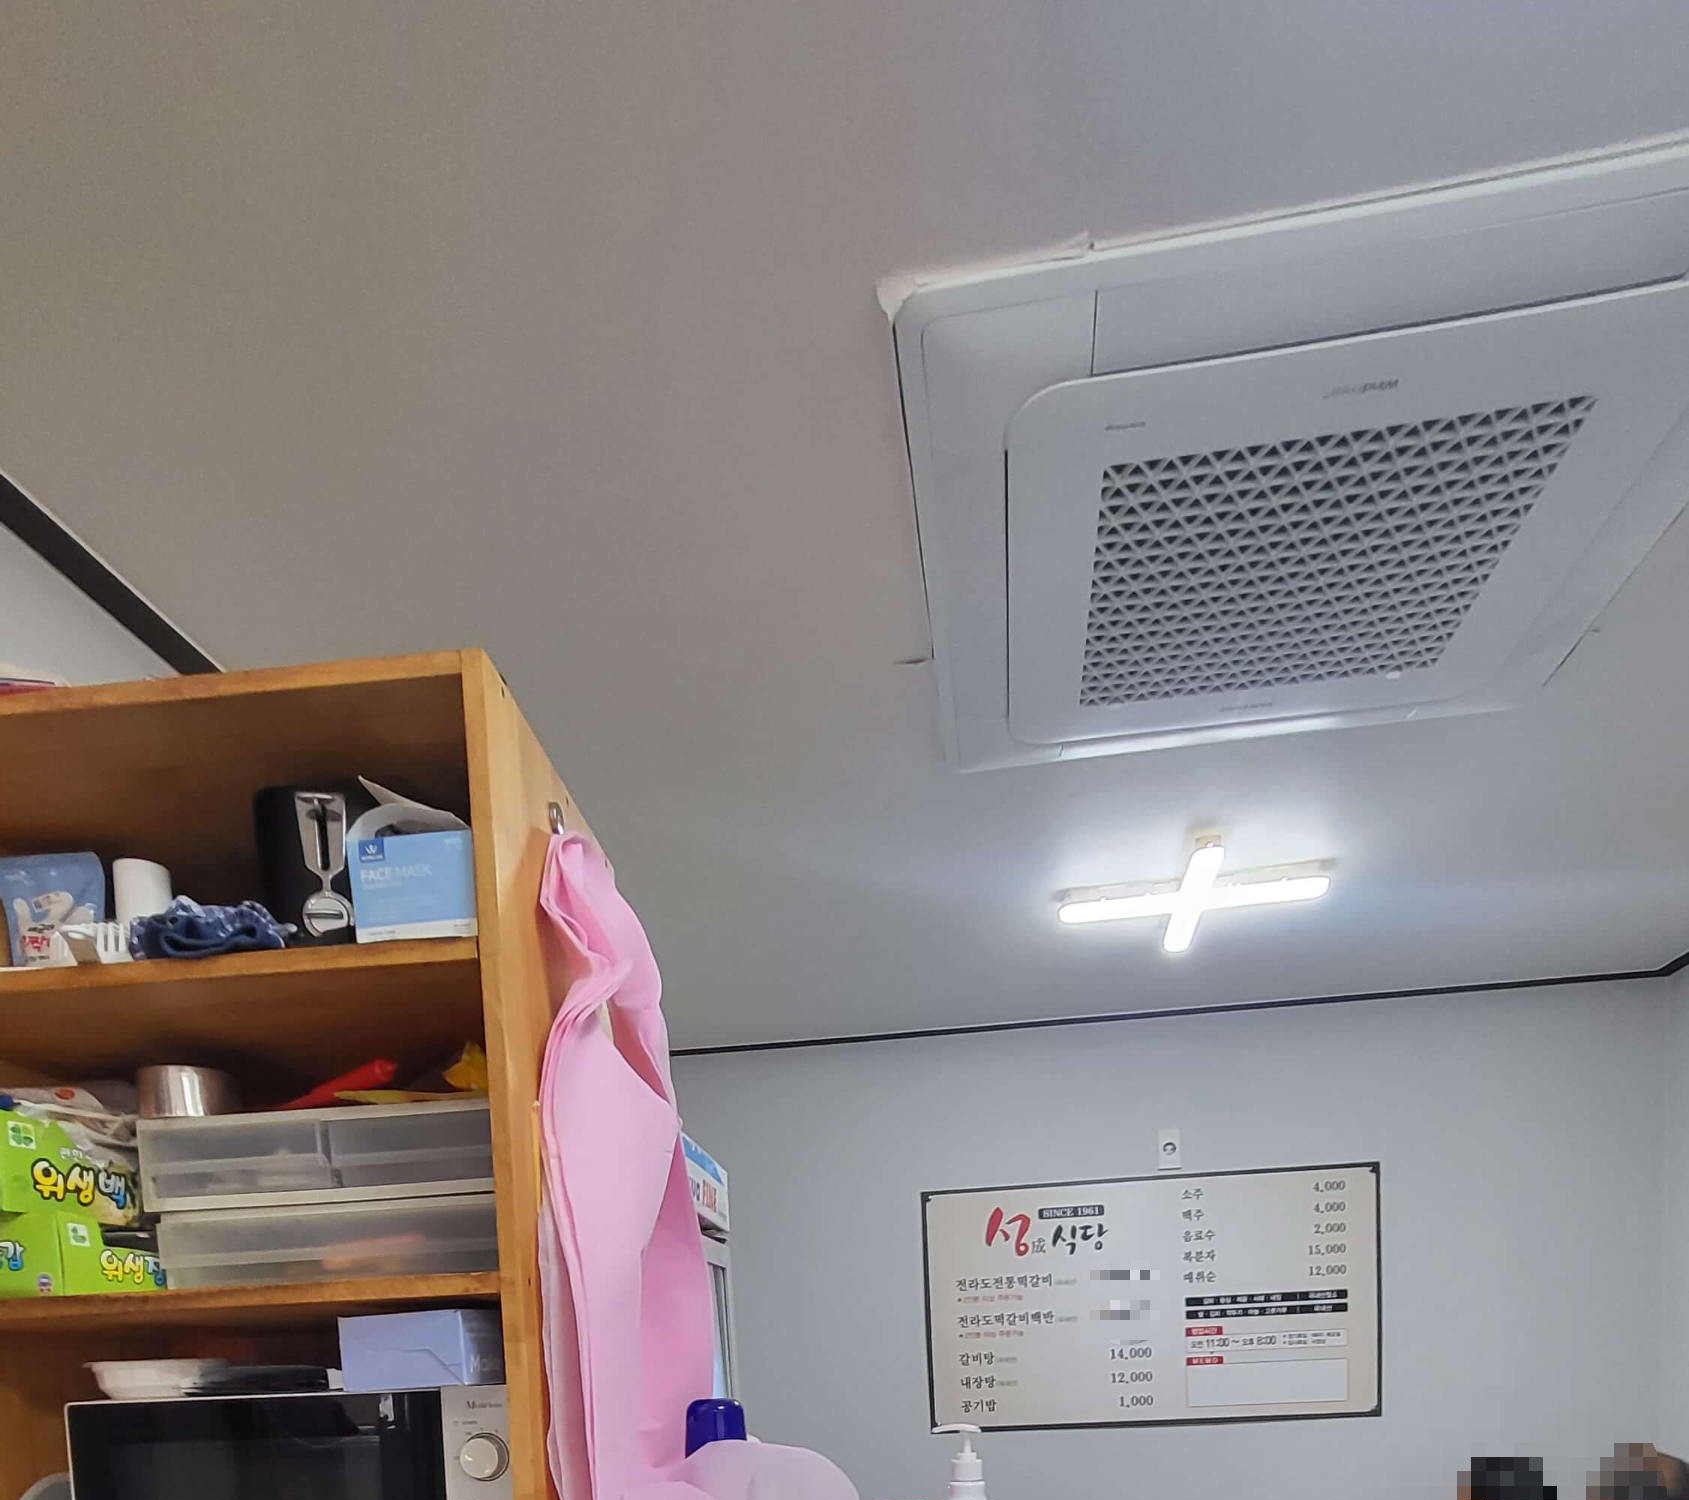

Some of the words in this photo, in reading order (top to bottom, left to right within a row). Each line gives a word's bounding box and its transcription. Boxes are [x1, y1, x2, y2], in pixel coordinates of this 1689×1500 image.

[360, 866, 392, 882] FACE
[1182, 1188, 1204, 1200] 소주
[1042, 1207, 1074, 1218] SINCE
[1077, 1206, 1101, 1216] 1961
[0, 1240, 24, 1271] 갑
[956, 1273, 1053, 1292] 전라도전통떡갈비
[957, 1311, 1055, 1328] 전라도떡갈비백반
[959, 1351, 995, 1366] 갈비탕
[961, 1376, 996, 1390] 내장탕
[961, 1399, 997, 1413] 공기밥
